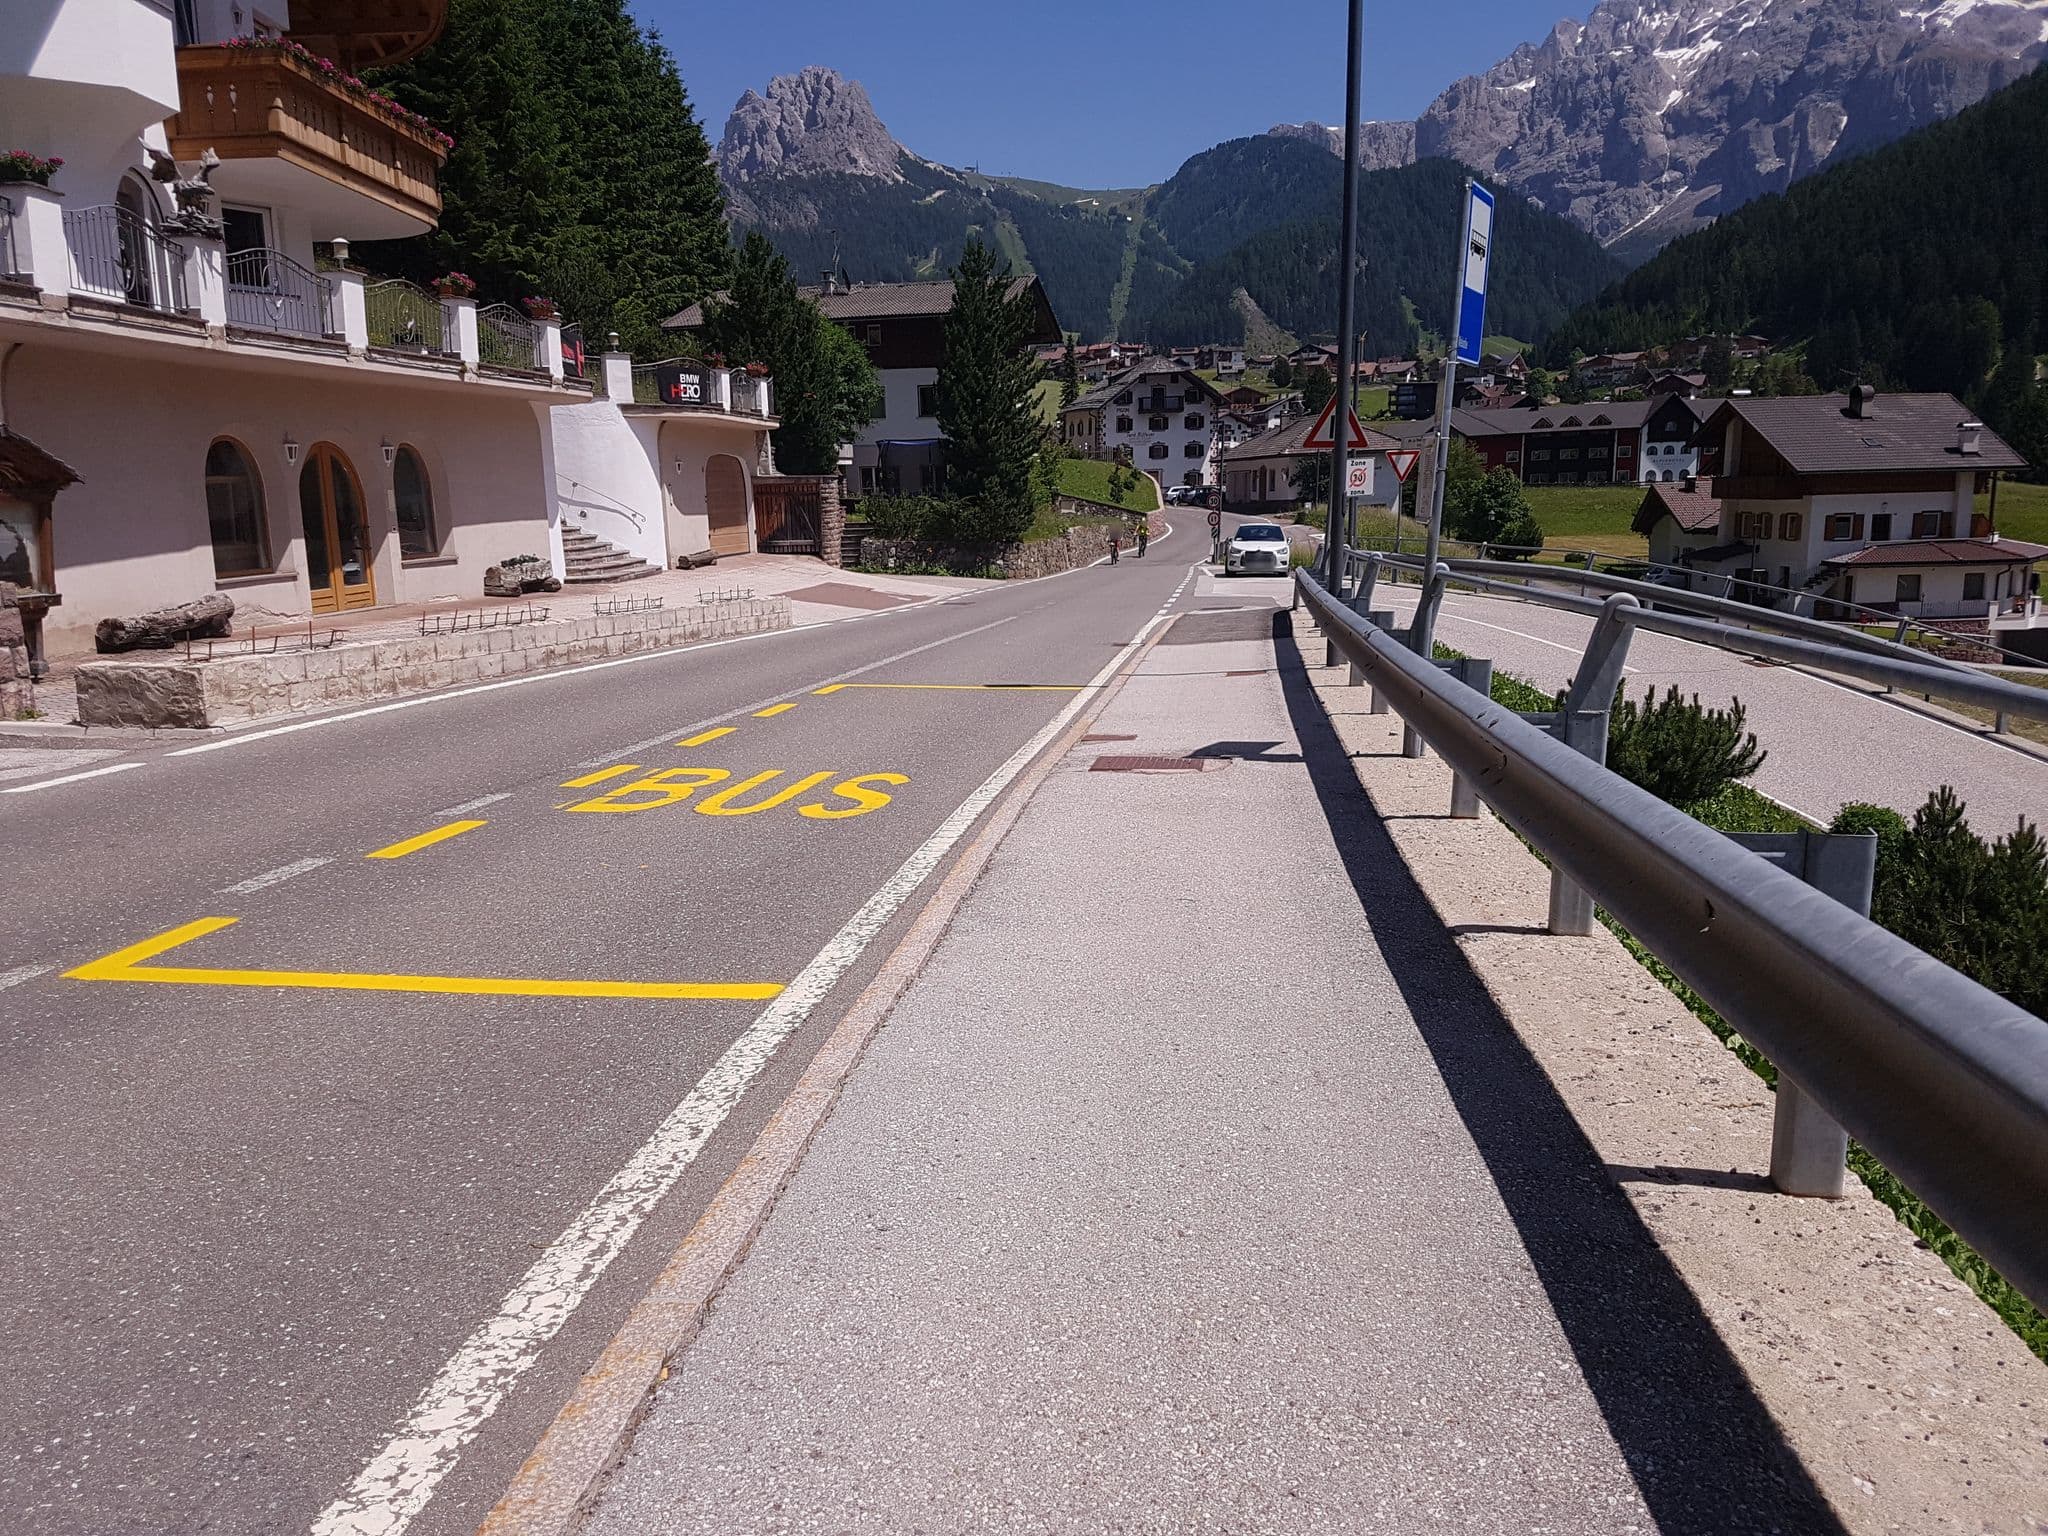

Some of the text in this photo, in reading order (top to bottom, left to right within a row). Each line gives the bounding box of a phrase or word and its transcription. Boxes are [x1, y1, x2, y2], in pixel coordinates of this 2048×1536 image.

[680, 373, 700, 384] BMW
[671, 384, 701, 398] HERO
[1353, 473, 1363, 482] 30
[568, 767, 910, 819] BUS
